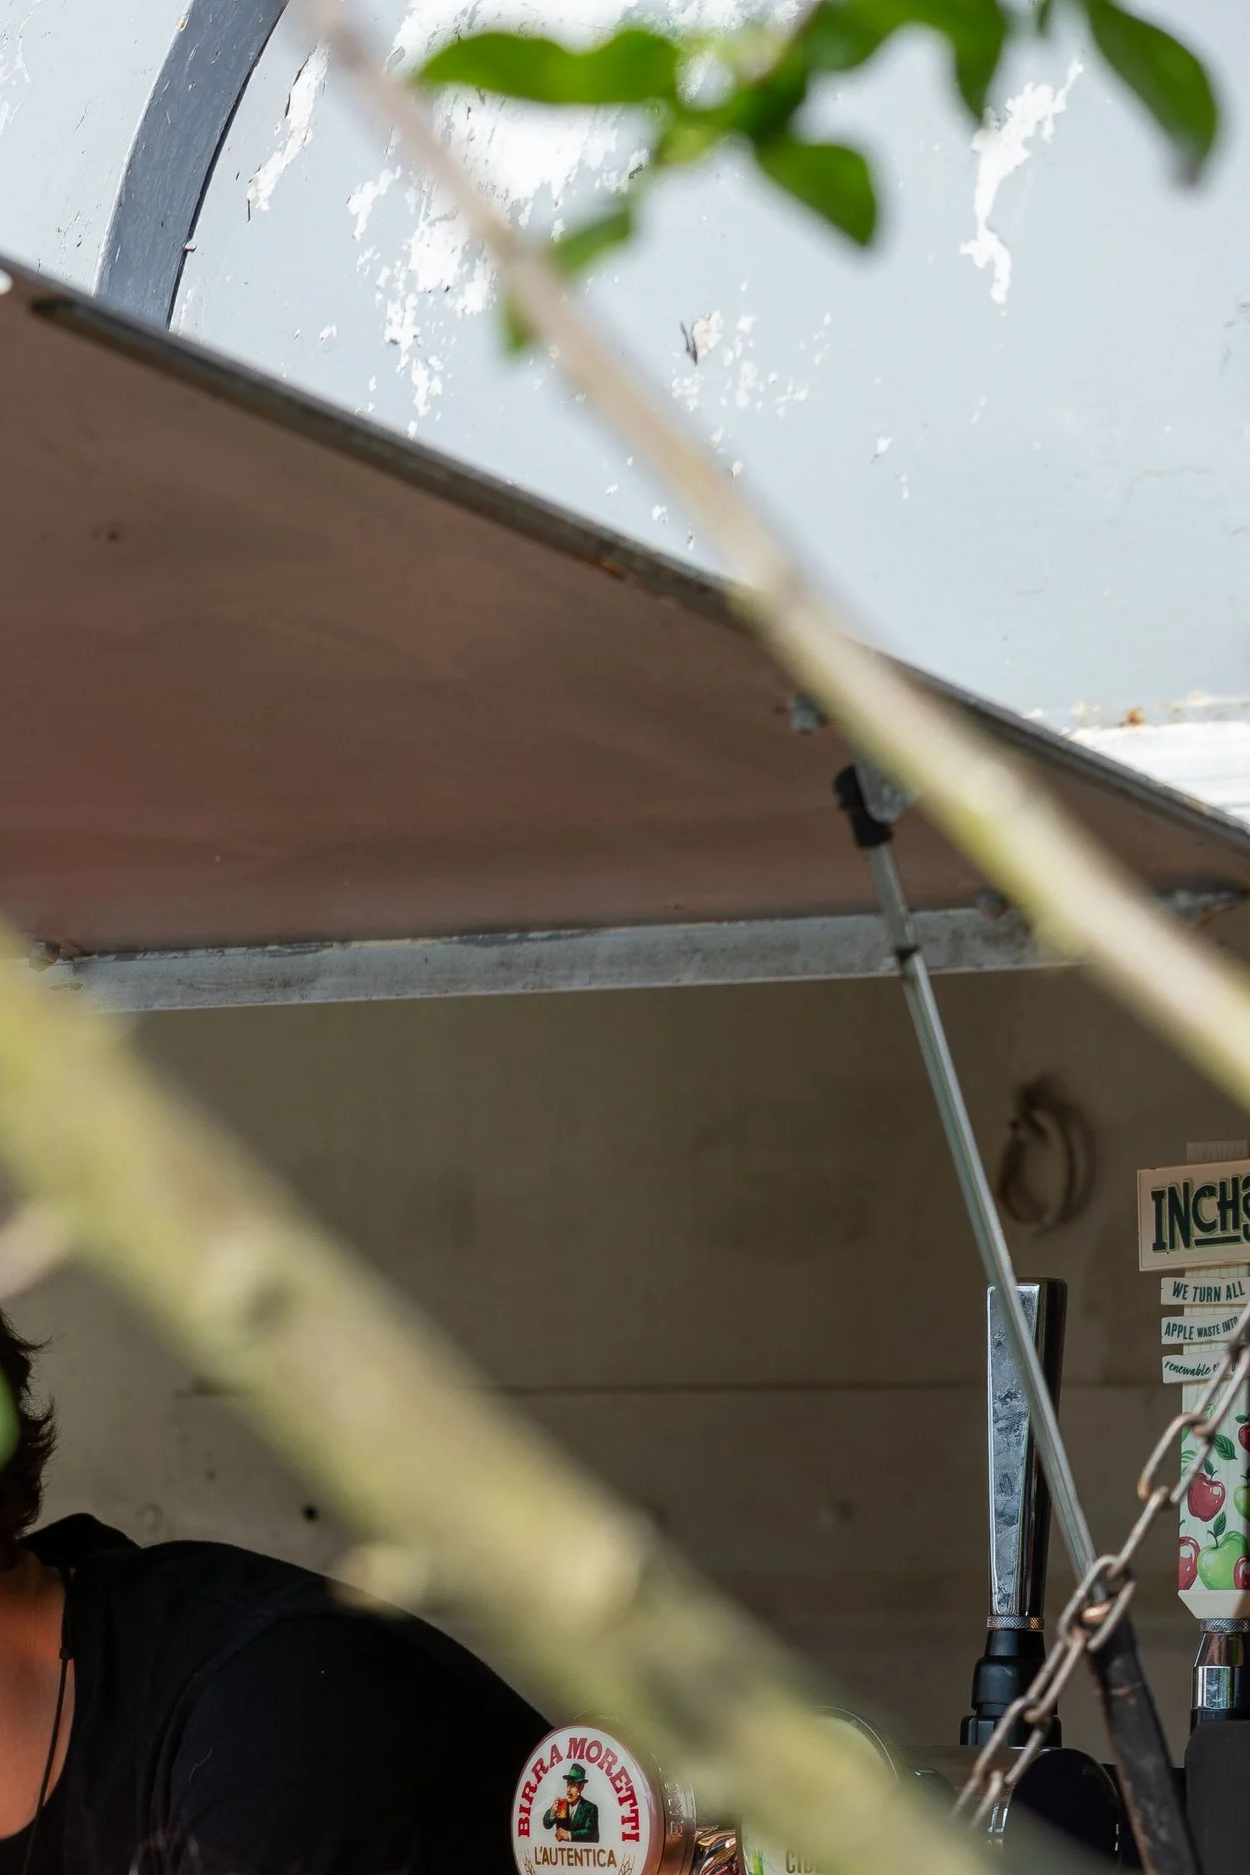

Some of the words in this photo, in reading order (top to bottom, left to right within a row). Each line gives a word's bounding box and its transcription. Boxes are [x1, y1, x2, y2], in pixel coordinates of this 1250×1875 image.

[1172, 1280, 1190, 1301] WE
[1192, 1286, 1221, 1303] TURN
[1225, 1280, 1246, 1301] ALL
[1164, 1321, 1195, 1340] APPLE
[1196, 1323, 1221, 1338] WASTE
[1164, 1361, 1211, 1377] renewable
[517, 1743, 563, 1838] BIRRA
[566, 1737, 640, 1842] MORETTI
[534, 1846, 617, 1868] L'AUTENTICA
